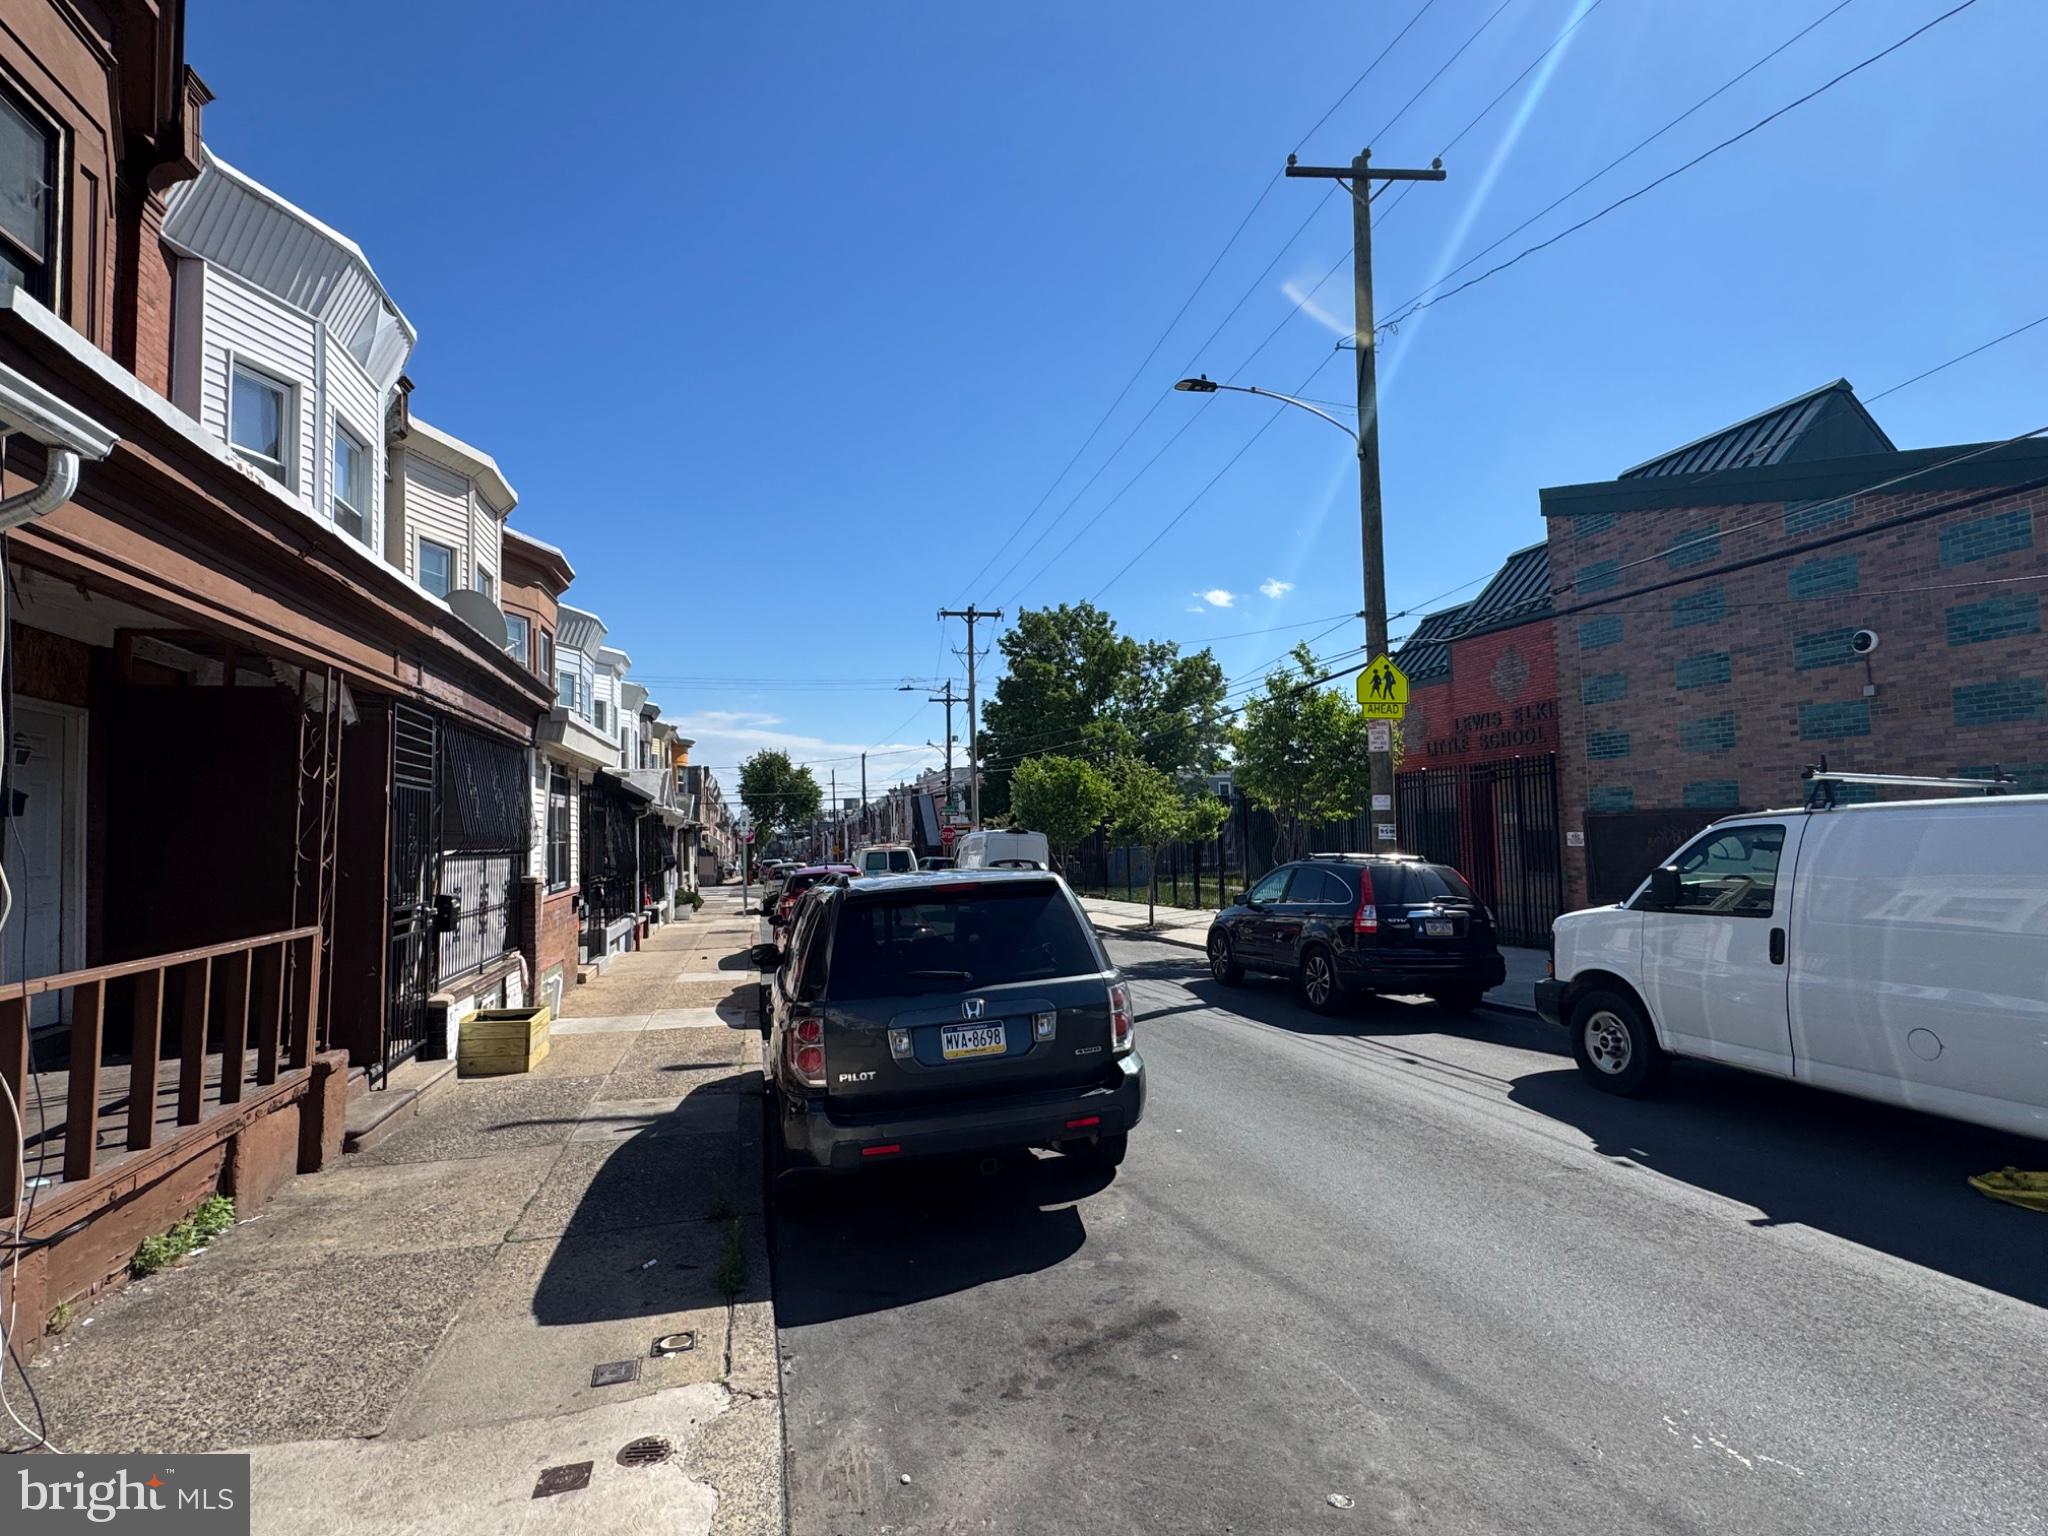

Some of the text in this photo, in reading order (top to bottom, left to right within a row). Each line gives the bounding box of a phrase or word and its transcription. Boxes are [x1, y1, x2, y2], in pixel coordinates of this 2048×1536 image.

[1367, 704, 1399, 714] AHEAD
[1455, 711, 1502, 733] LEWIS
[1427, 727, 1547, 757] LITTLE SCHOOL
[941, 831, 955, 840] STOP
[839, 1071, 876, 1083] PILOT
